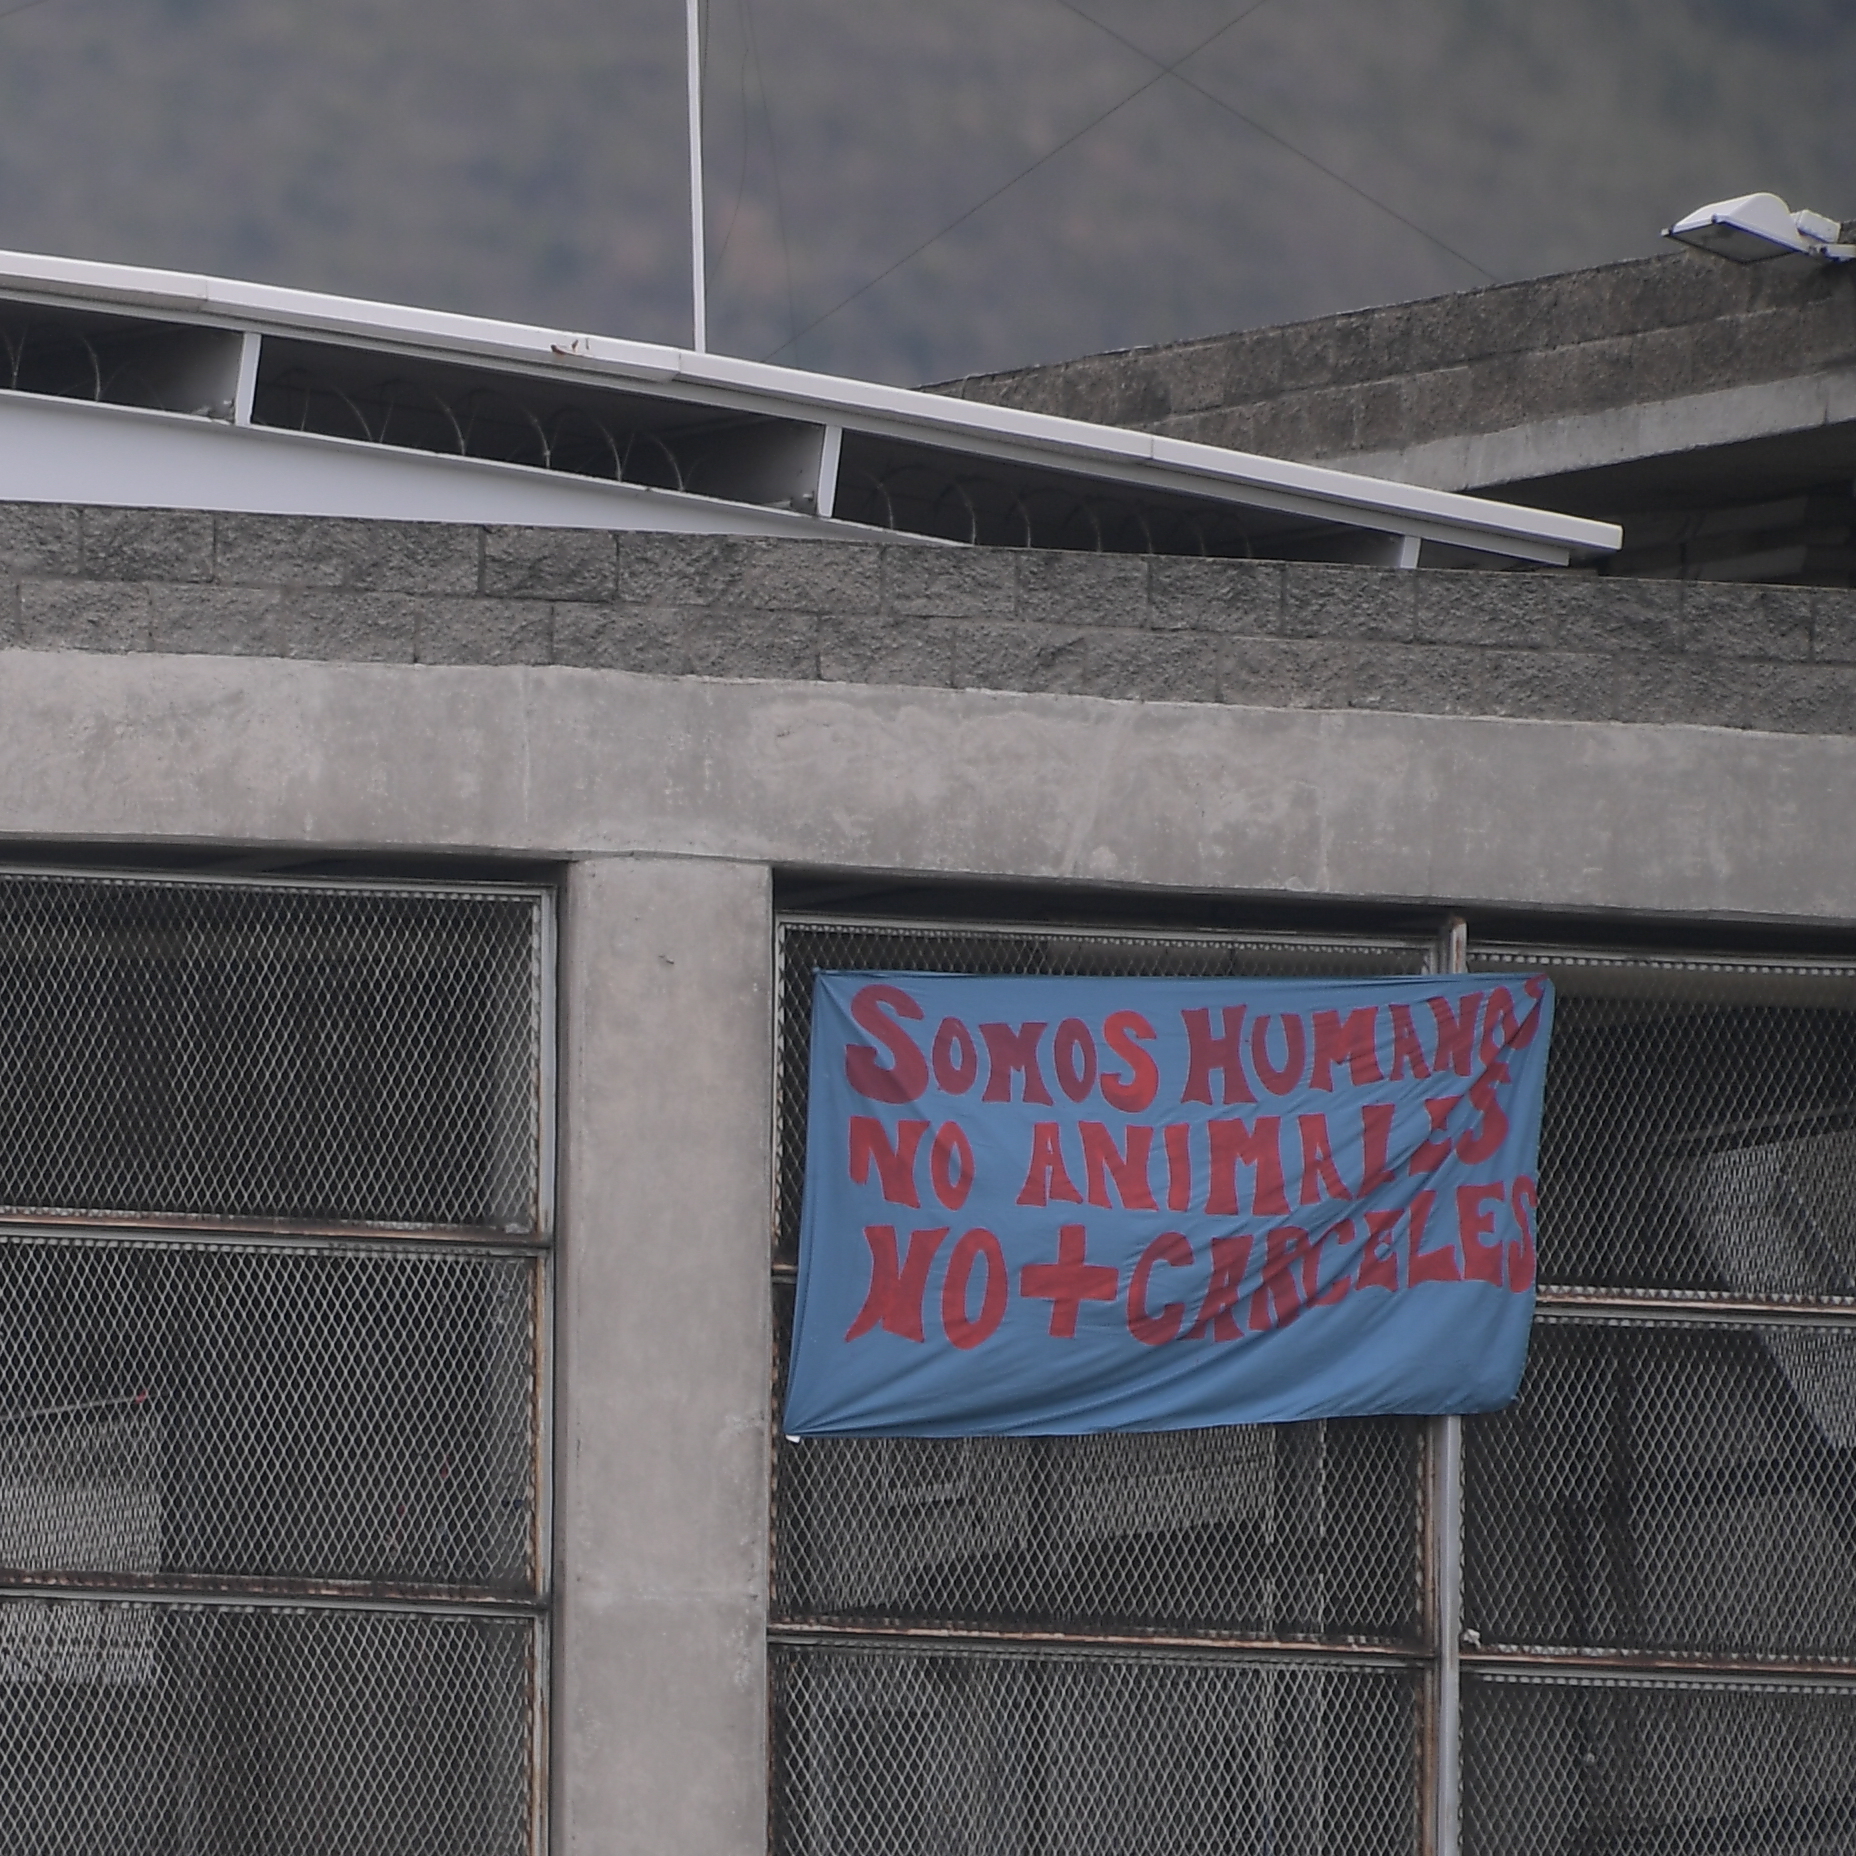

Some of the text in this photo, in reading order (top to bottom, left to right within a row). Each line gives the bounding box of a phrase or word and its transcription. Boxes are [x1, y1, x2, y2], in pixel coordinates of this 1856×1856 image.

[844, 972, 1549, 1113] SOMOS HUMANOS
[848, 1060, 1511, 1216] NO ANIMALES
